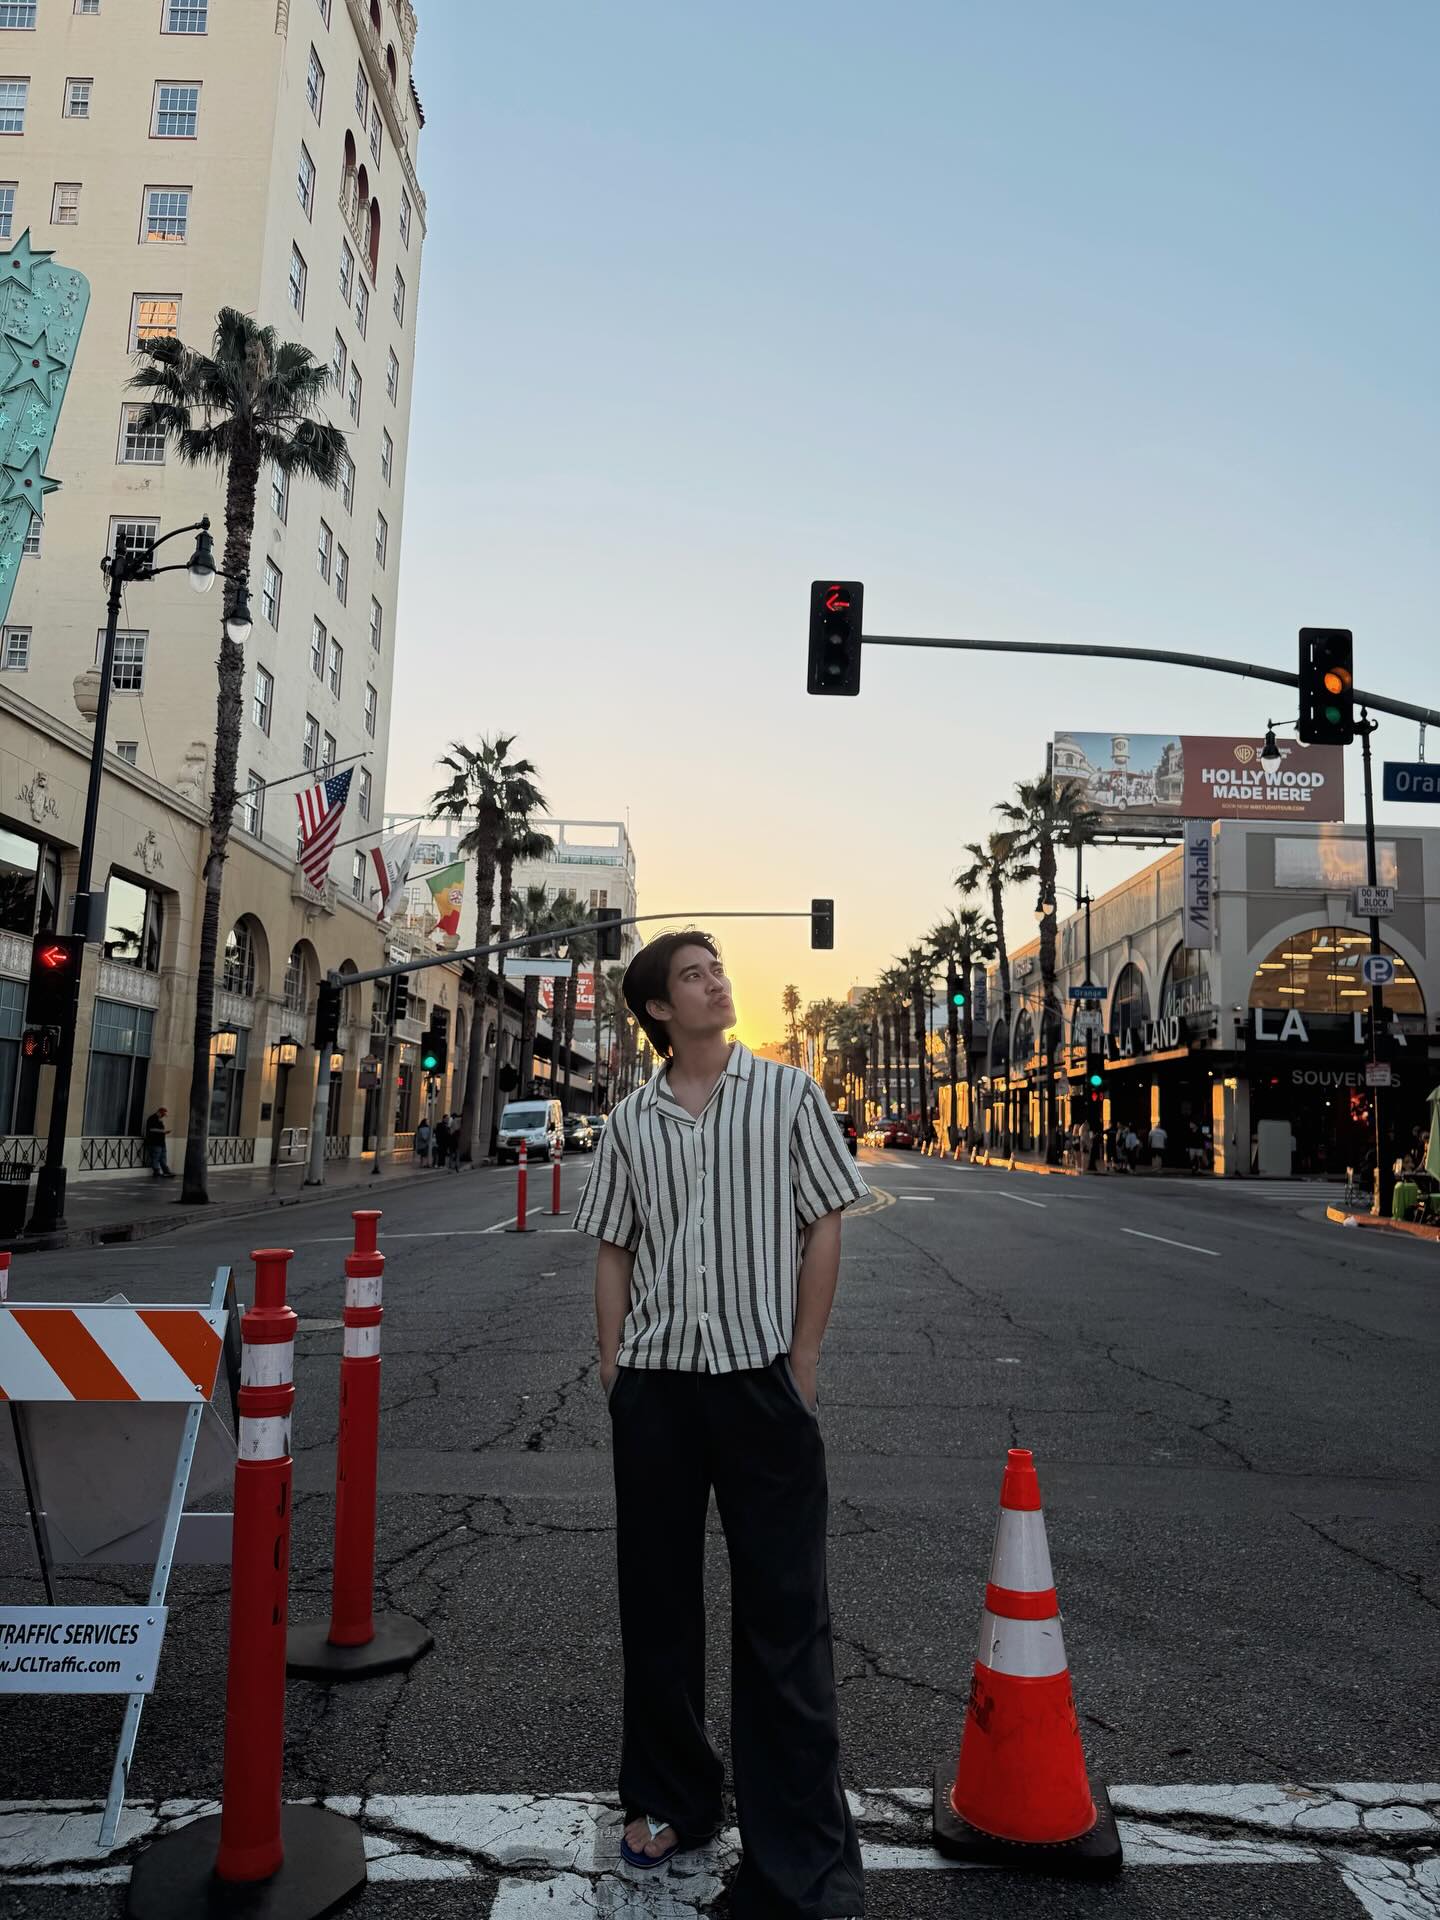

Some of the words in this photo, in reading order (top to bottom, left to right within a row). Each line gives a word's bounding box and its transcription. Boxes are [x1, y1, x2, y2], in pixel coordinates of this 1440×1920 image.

[1201, 768, 1325, 787] HOLLYWOOD
[1396, 771, 1440, 792] Ora
[1213, 785, 1263, 800] MADE
[1266, 787, 1312, 801] HERE
[1190, 839, 1209, 930] Marshalls
[1361, 889, 1372, 897] DO
[1375, 889, 1389, 898] NOT
[1364, 899, 1388, 907] BLOCK
[1074, 988, 1101, 997] Orange
[1144, 1016, 1180, 1051] LAND
[1254, 1008, 1309, 1042] LA
[1292, 1070, 1401, 1087] SOUVENS
[63, 1624, 140, 1644] SERVICES
